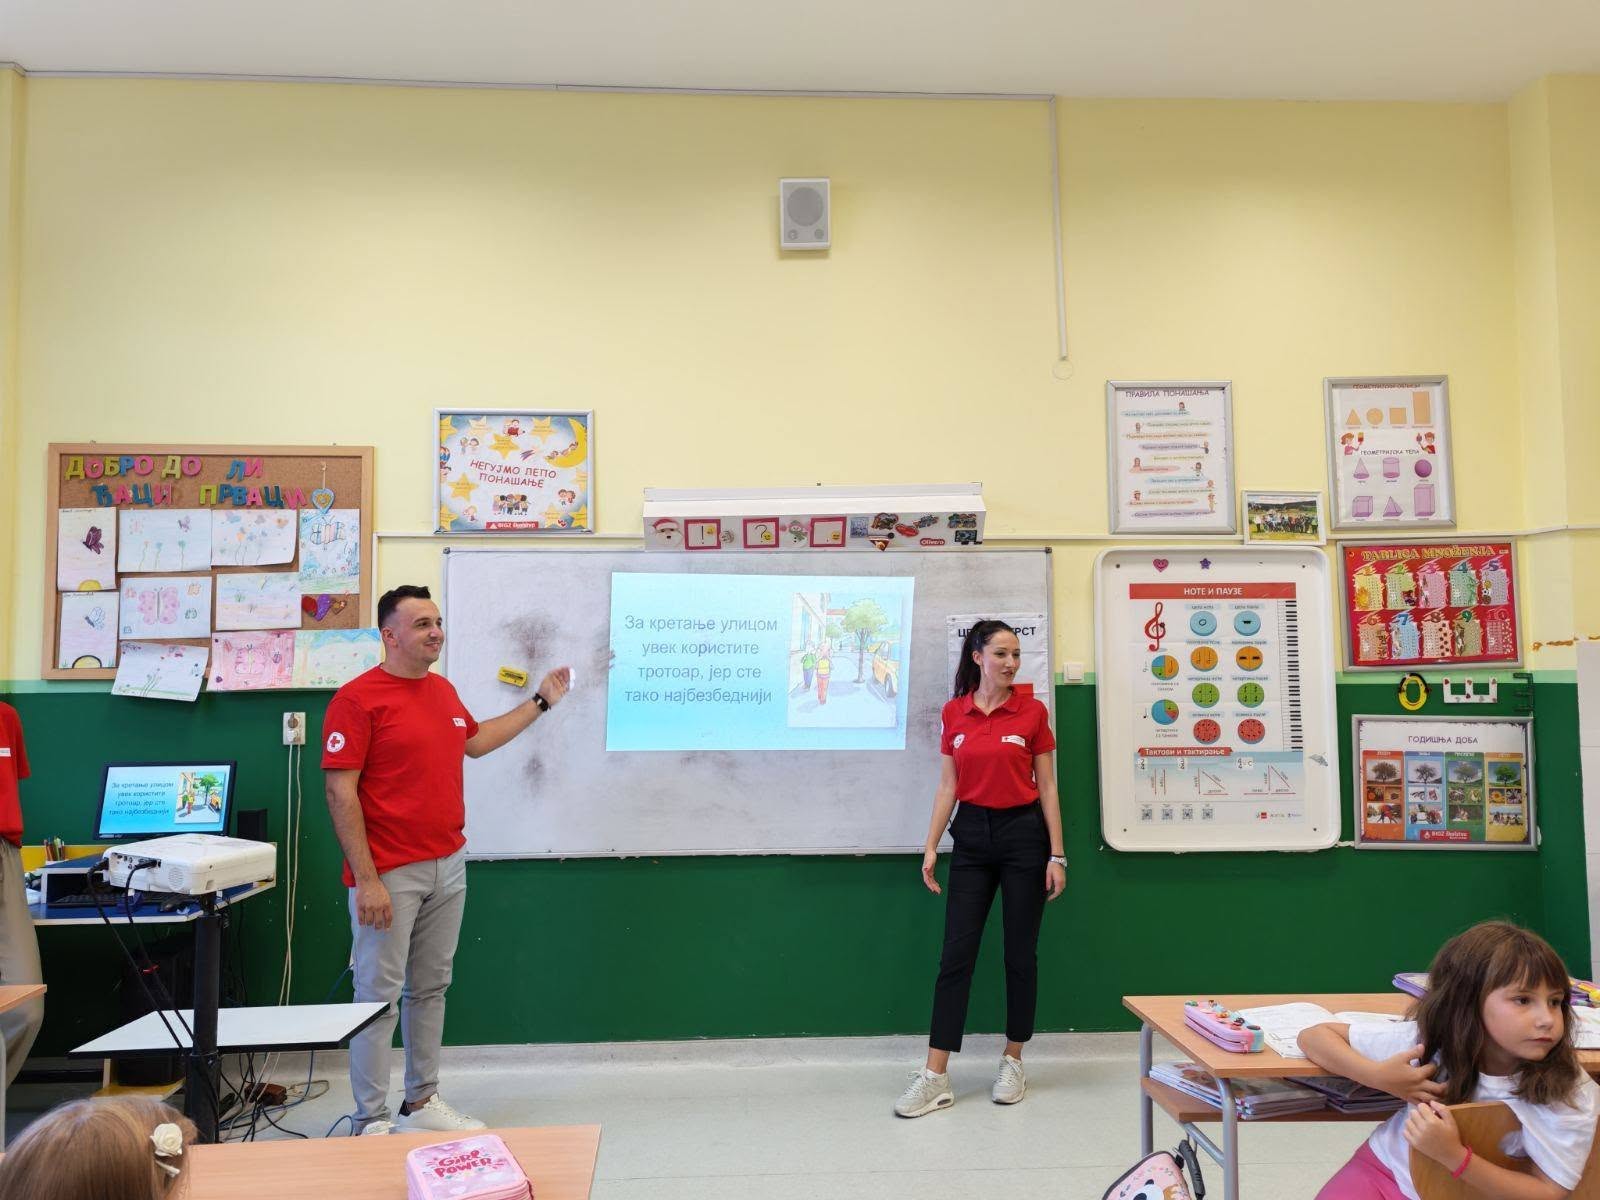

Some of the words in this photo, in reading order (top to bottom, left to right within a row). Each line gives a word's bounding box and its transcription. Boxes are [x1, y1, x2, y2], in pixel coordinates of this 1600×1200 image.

[1125, 389, 1160, 398] ПРАВИЛА
[1163, 388, 1209, 397] ПОНАШАЊА
[65, 455, 154, 481] ДОБРО
[160, 455, 202, 480] ДО
[470, 459, 521, 475] НЕГУЈМО
[525, 469, 557, 479] ЛЕПО
[479, 472, 544, 488] ПОНАШАЊЕ
[199, 483, 308, 510] ПРВАЦИ
[1183, 587, 1207, 596] НОТЕ
[1208, 587, 1214, 595] И
[1215, 587, 1242, 596] ПАУЗЕ
[624, 615, 645, 630] За
[649, 617, 716, 633] кретање
[720, 617, 778, 633] улицом
[641, 642, 677, 656] увек
[681, 642, 759, 657] користите
[637, 666, 704, 680] тротоар,
[708, 664, 732, 681] јер
[736, 667, 762, 679] сте
[625, 690, 660, 702] тако
[664, 688, 772, 705] најбезбеднији
[1408, 735, 1452, 744] ГОДИШЊА
[1455, 736, 1479, 744] ДОБА
[1145, 748, 1175, 756] Тактови
[1184, 749, 1225, 757] тактирање
[434, 1158, 491, 1177] POWER
